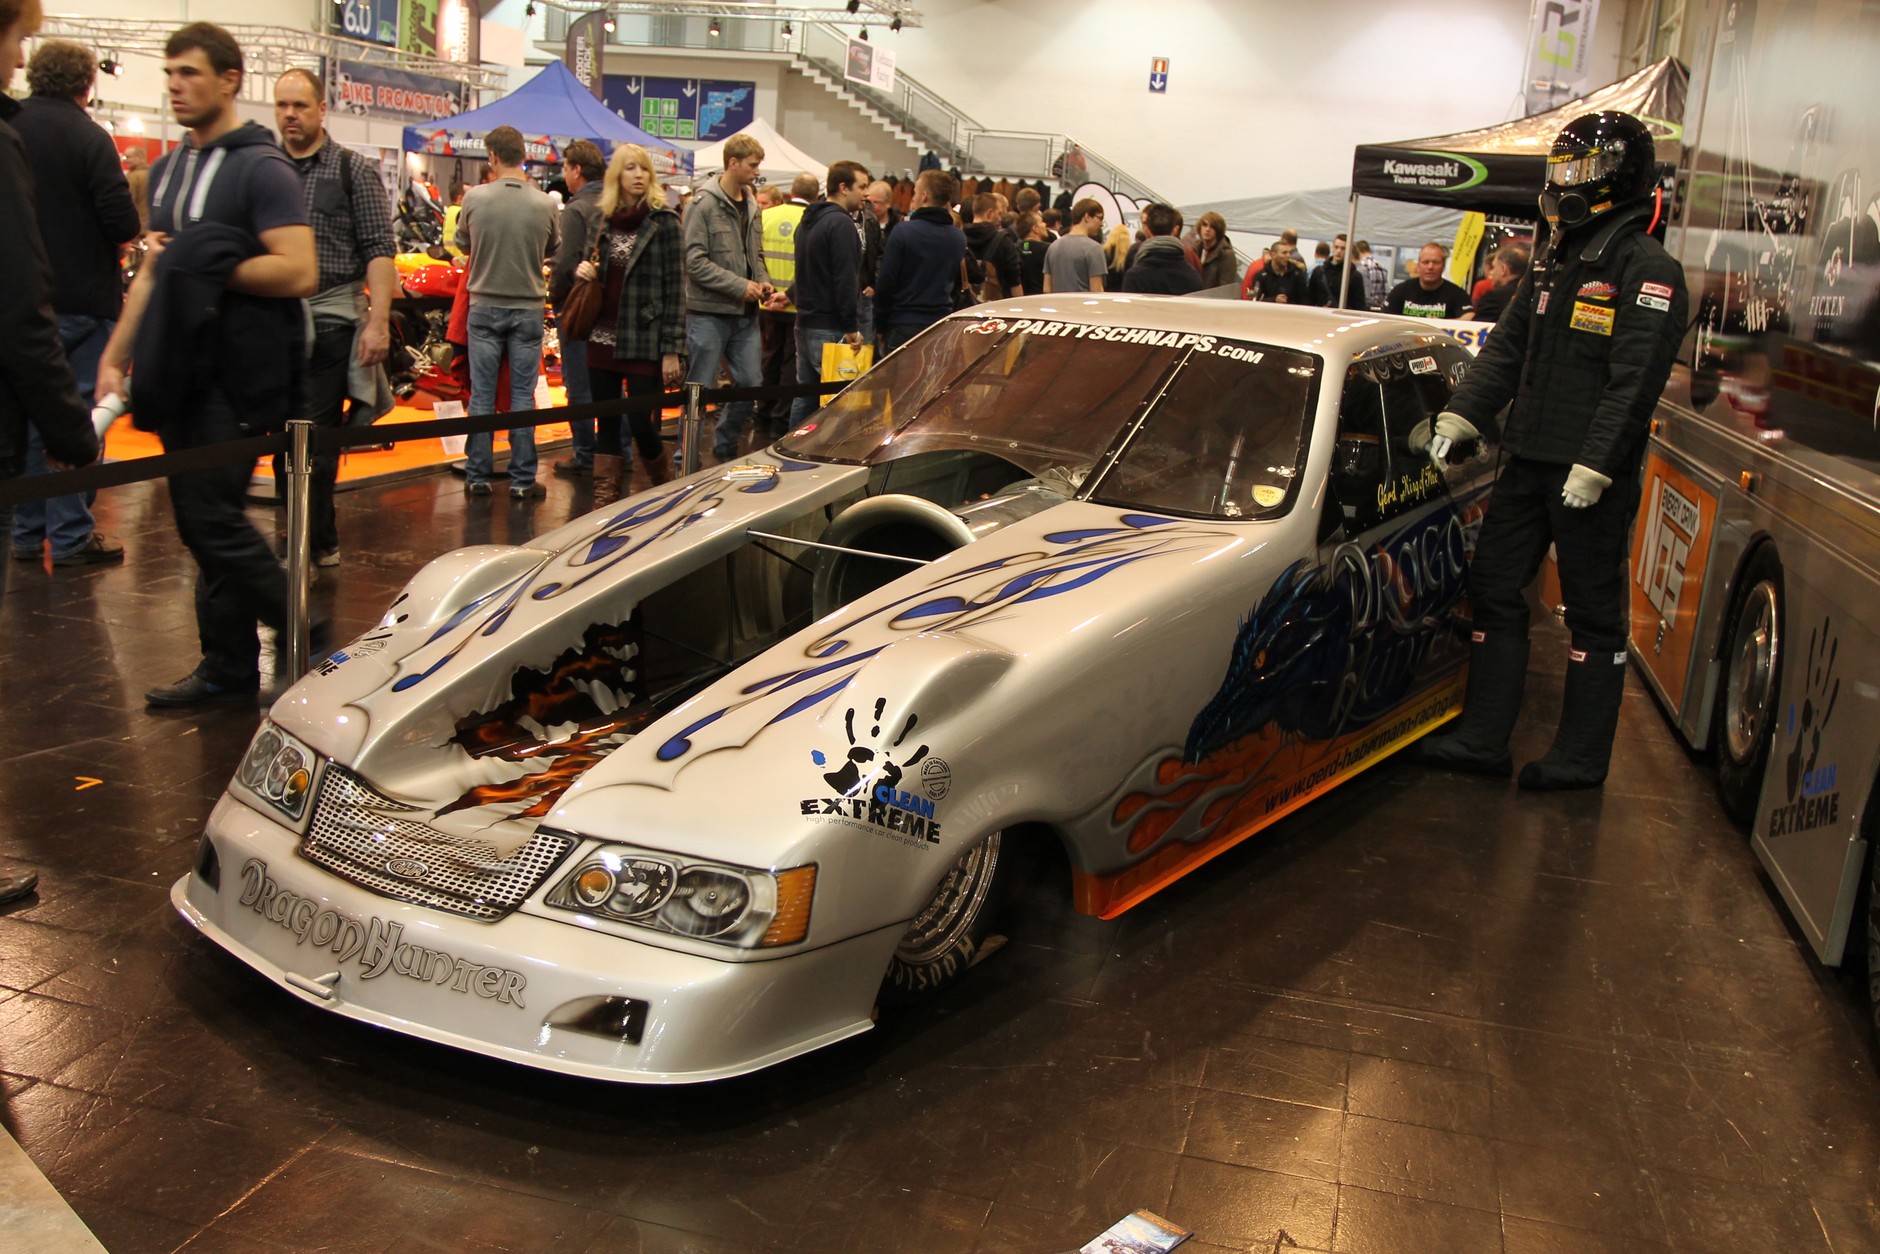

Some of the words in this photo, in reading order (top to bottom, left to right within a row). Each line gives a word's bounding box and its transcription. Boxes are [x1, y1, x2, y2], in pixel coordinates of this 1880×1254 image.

[341, 81, 374, 105] BIKE
[377, 85, 453, 118] PROMOTION
[1383, 160, 1459, 177] Kawasaki
[1393, 175, 1417, 184] Team
[1418, 177, 1447, 186] Green
[1404, 300, 1447, 312] Kawasaki
[1581, 304, 1606, 314] DHL
[1809, 295, 1846, 316] FICKEN
[1377, 481, 1398, 515] Gerd
[1662, 487, 1682, 520] ENERGY
[1680, 499, 1699, 535] DRINK
[1636, 474, 1689, 631] NOS
[1802, 763, 1837, 800] CLEAN
[875, 785, 935, 820] CLEAN
[1769, 793, 1840, 838] EXTREME
[800, 798, 942, 845] EXTREME
[805, 815, 826, 824] high
[828, 815, 874, 834] performance
[874, 827, 886, 837] car
[885, 831, 903, 843] clean
[903, 837, 930, 851] products
[391, 860, 424, 876] GHR
